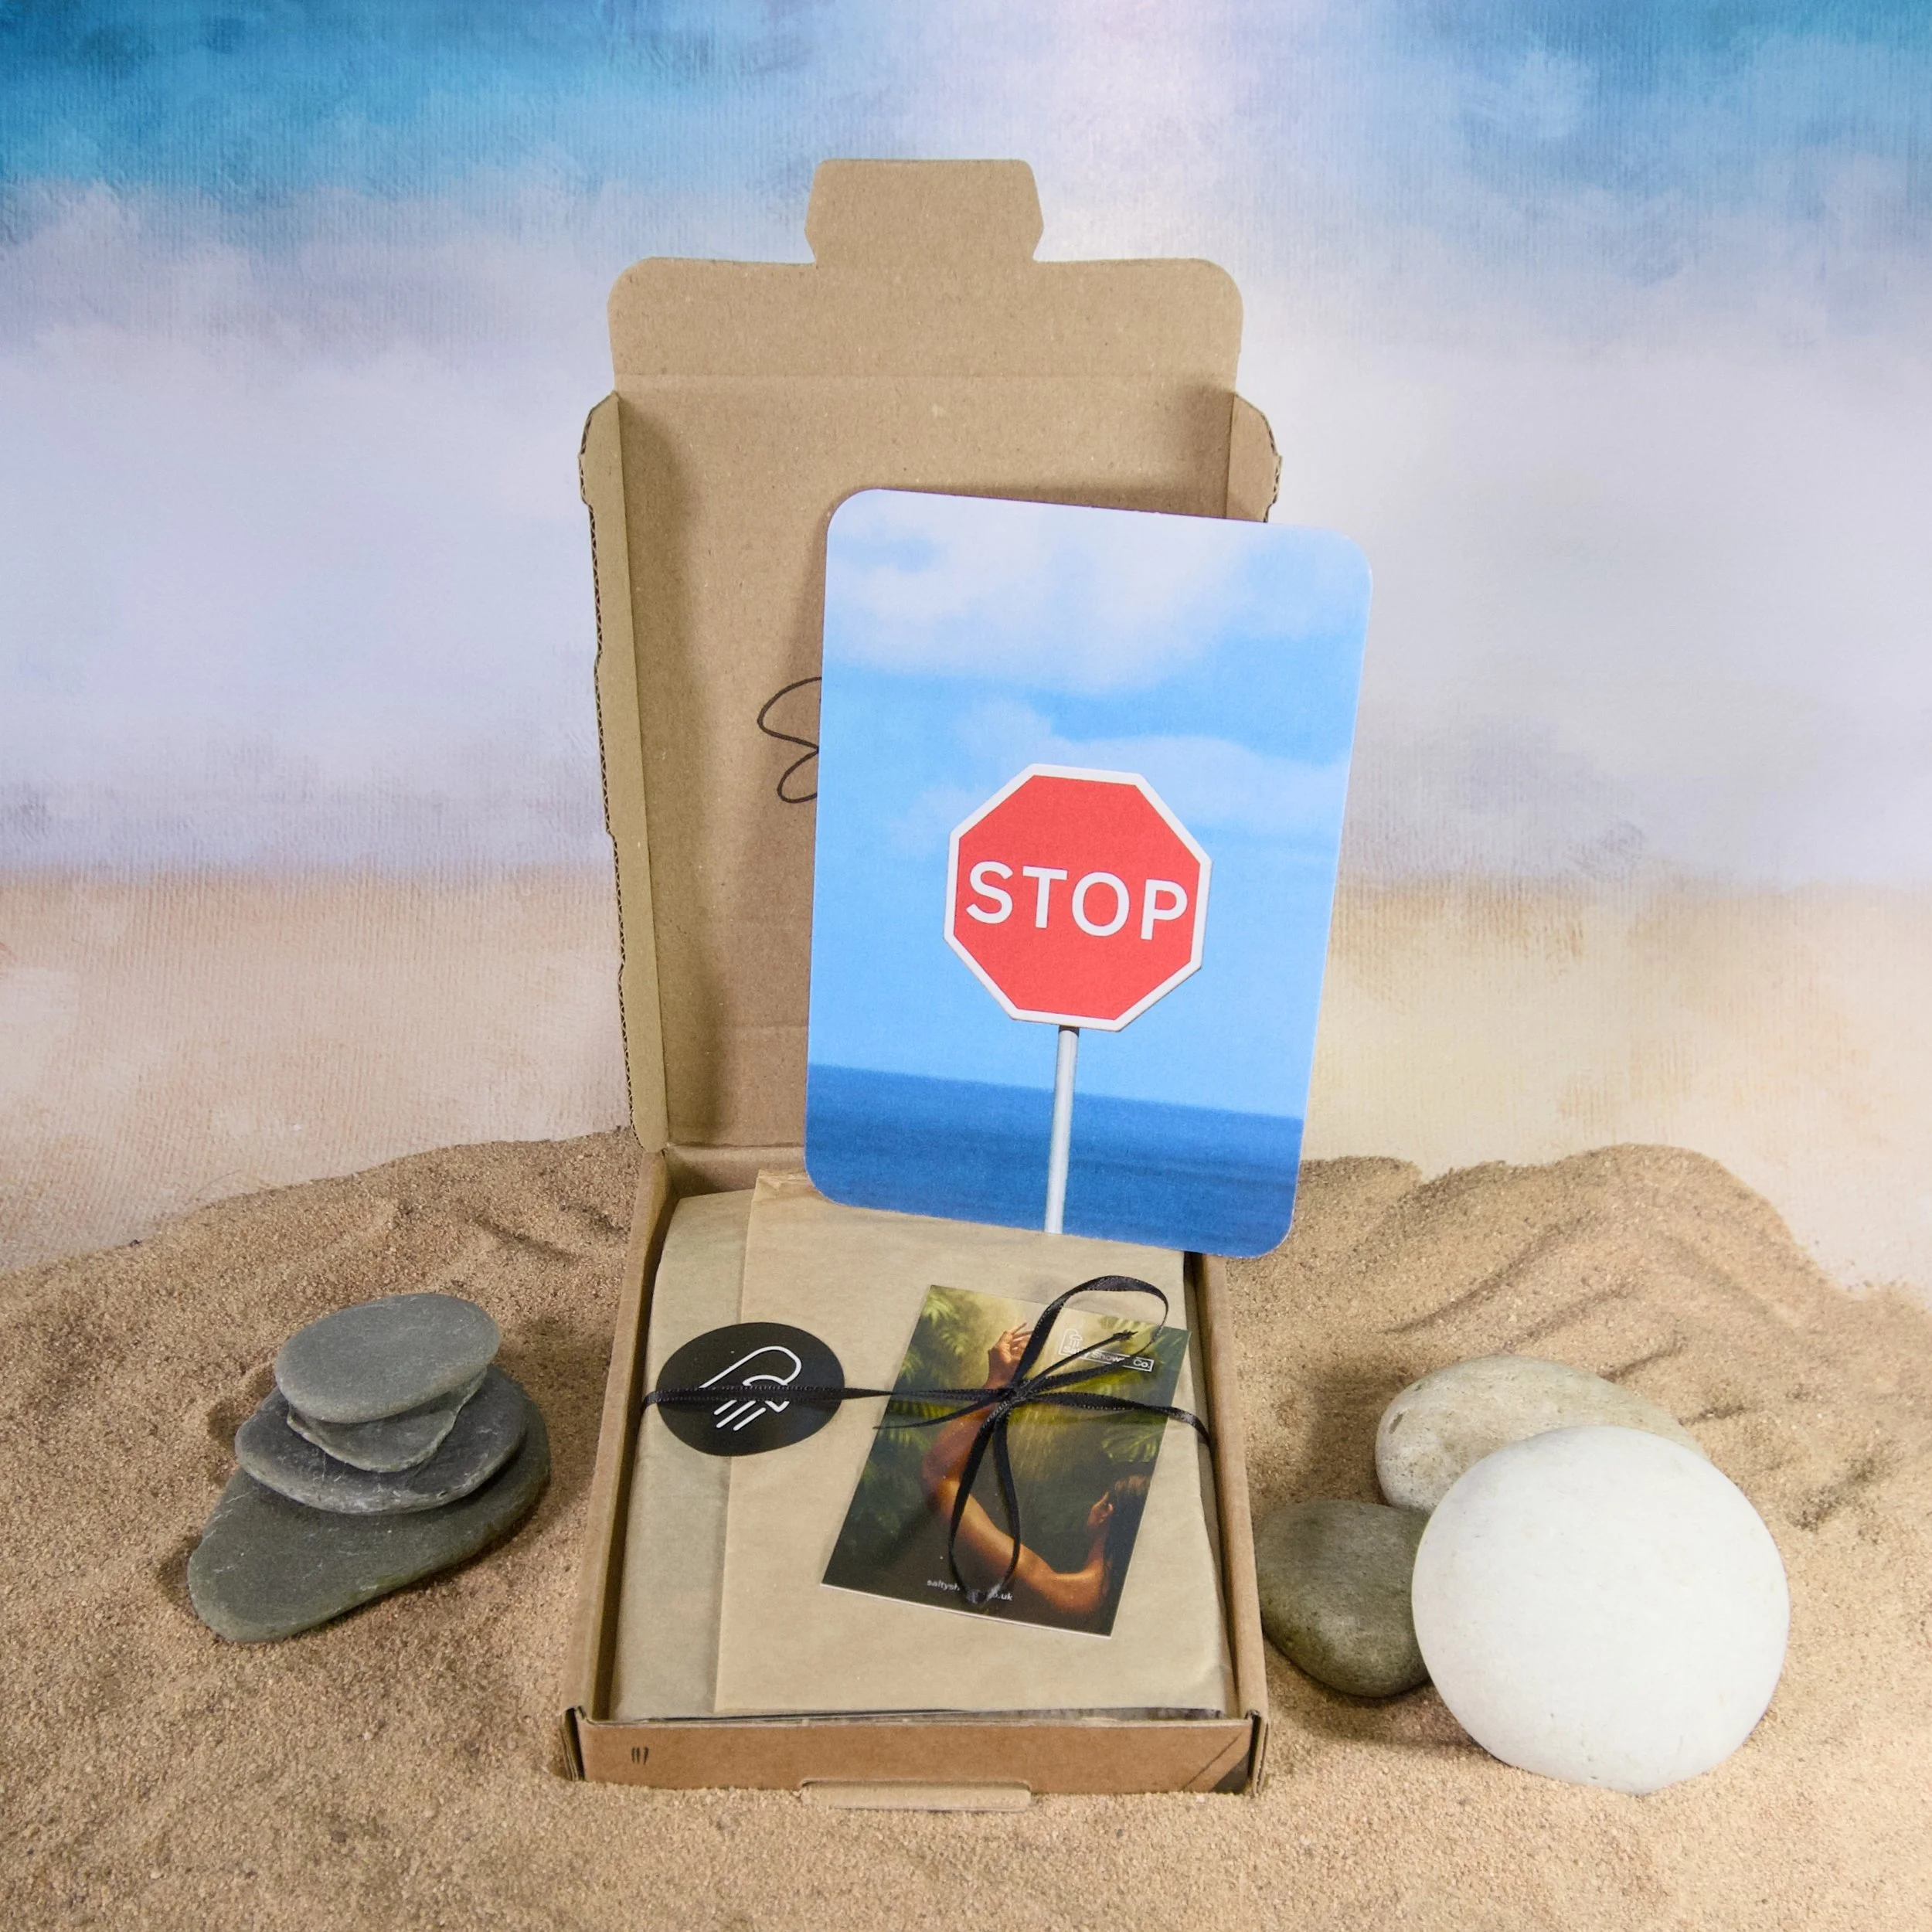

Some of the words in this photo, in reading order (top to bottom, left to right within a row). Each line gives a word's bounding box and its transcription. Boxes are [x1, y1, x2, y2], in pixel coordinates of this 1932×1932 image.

[966, 860, 1189, 940] STOP
[1090, 1350, 1131, 1366] Show
[927, 1579, 1013, 1601] saltysho.uk
